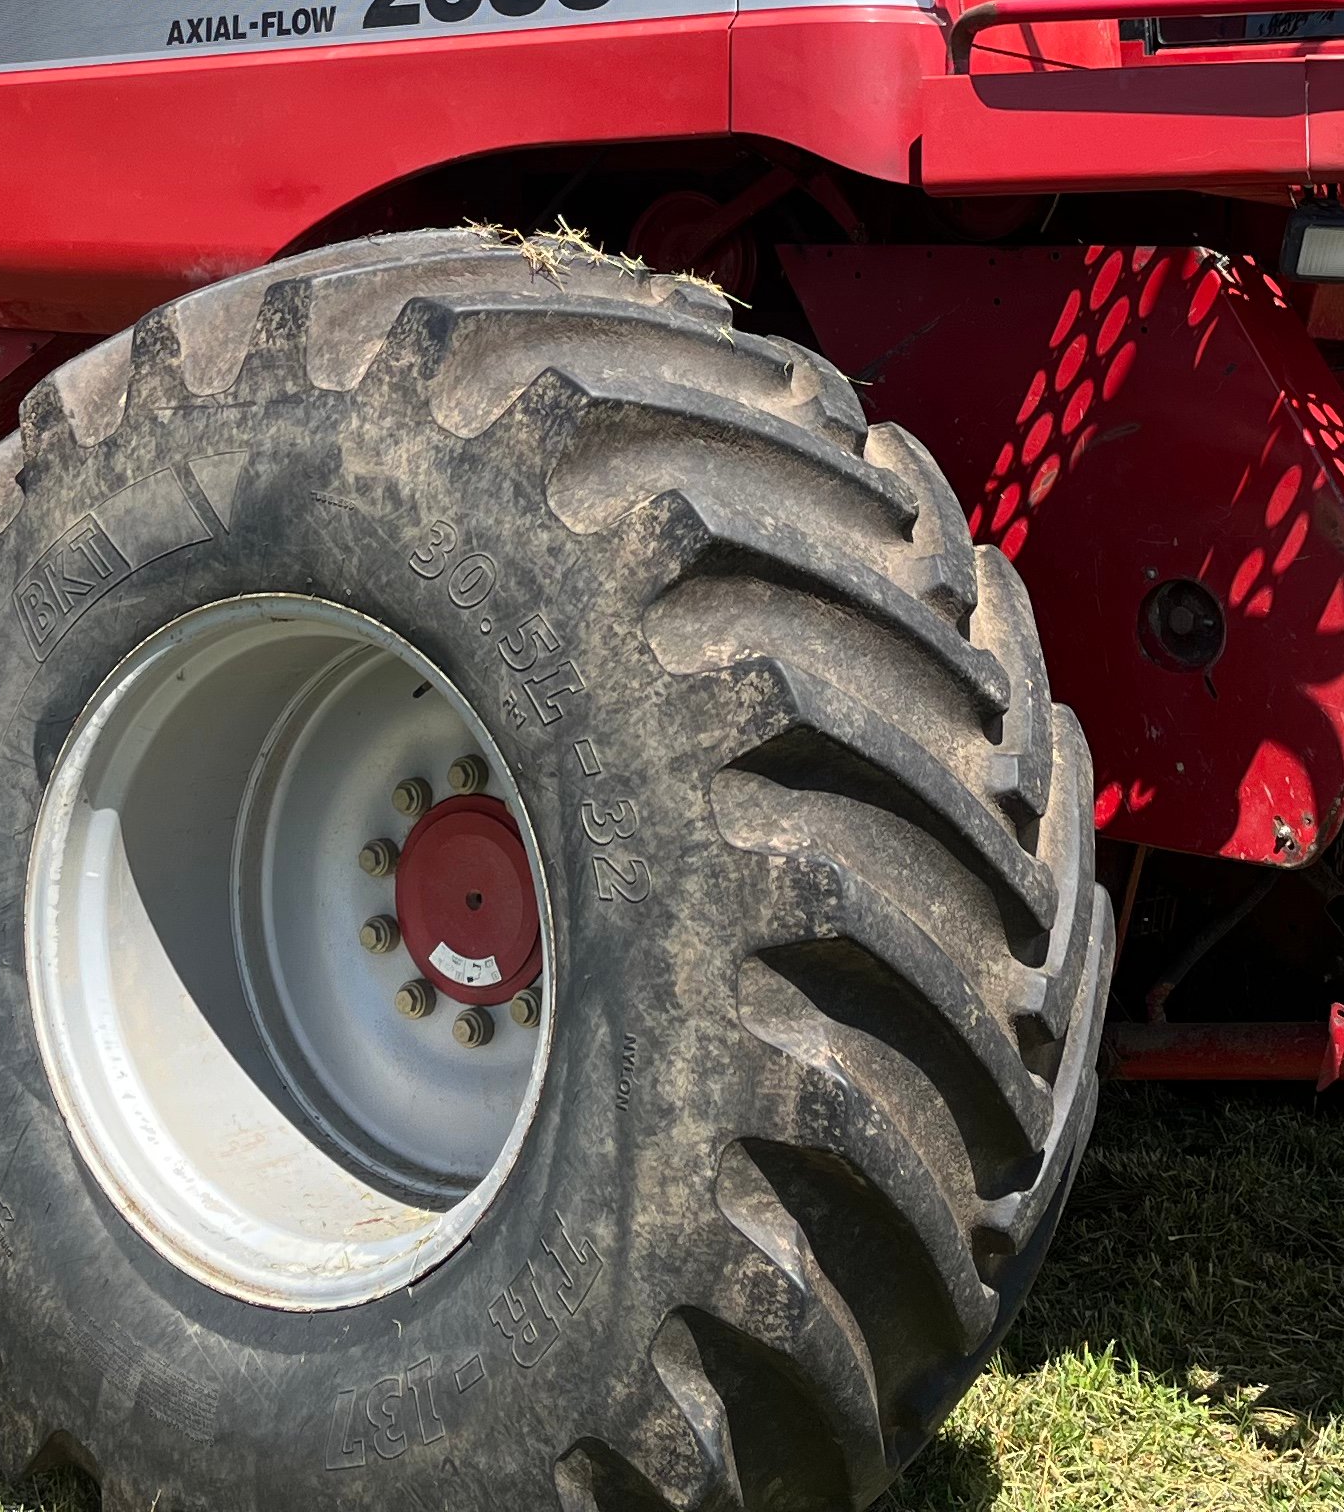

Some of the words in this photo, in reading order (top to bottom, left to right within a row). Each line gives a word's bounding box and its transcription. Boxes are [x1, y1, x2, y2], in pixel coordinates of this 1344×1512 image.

[166, 5, 337, 47] AXIAL-FLOW
[19, 523, 114, 647] BKT
[616, 1032, 637, 1112] NYLON
[325, 1209, 604, 1470] TR-137
